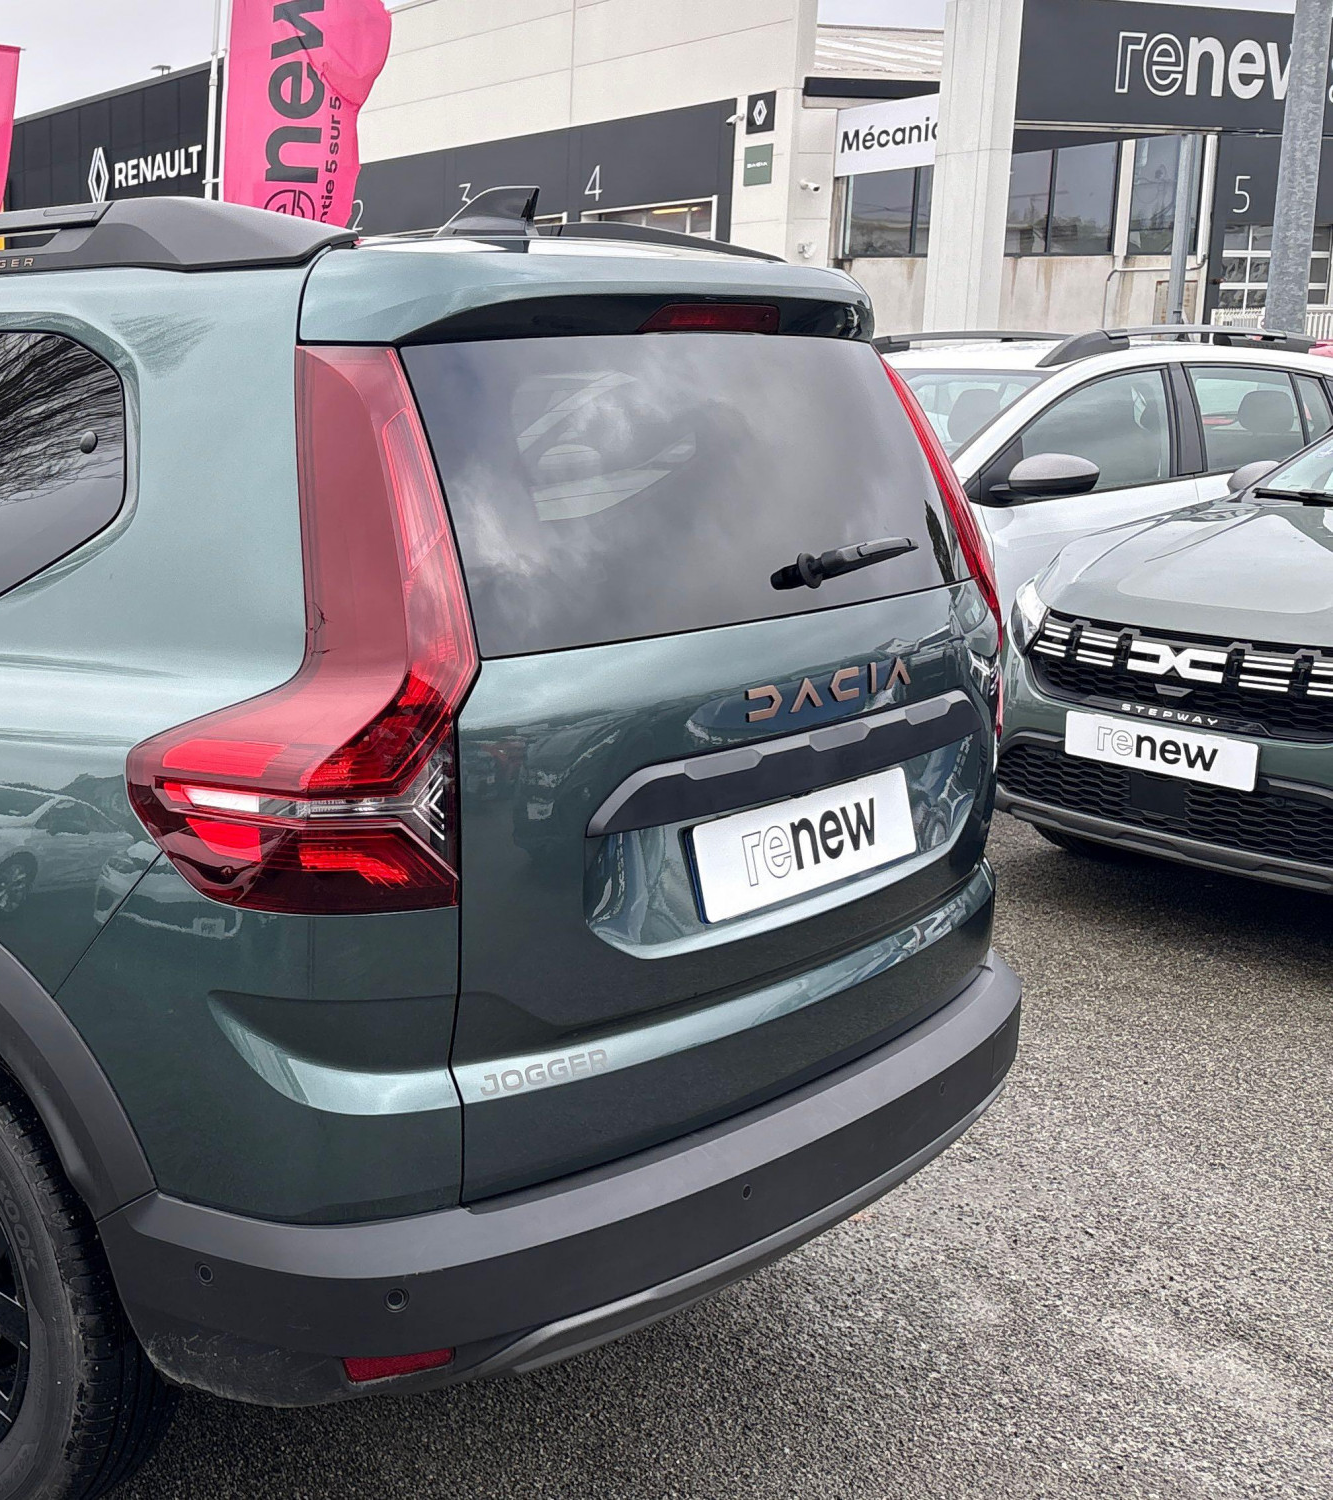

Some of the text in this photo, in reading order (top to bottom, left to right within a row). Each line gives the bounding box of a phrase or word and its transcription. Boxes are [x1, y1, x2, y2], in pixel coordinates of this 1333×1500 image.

[329, 95, 342, 111] 5
[330, 114, 342, 156] sur
[114, 144, 202, 189] RENAULT
[325, 159, 338, 174] 5
[584, 164, 604, 202] 4
[351, 199, 365, 231] 2
[1231, 174, 1252, 215] 5
[745, 656, 912, 723] DACIA
[1121, 703, 1219, 726] STEPWAY
[1095, 725, 1219, 772] renew
[740, 797, 876, 887] renew
[480, 1048, 608, 1097] JOGGER
